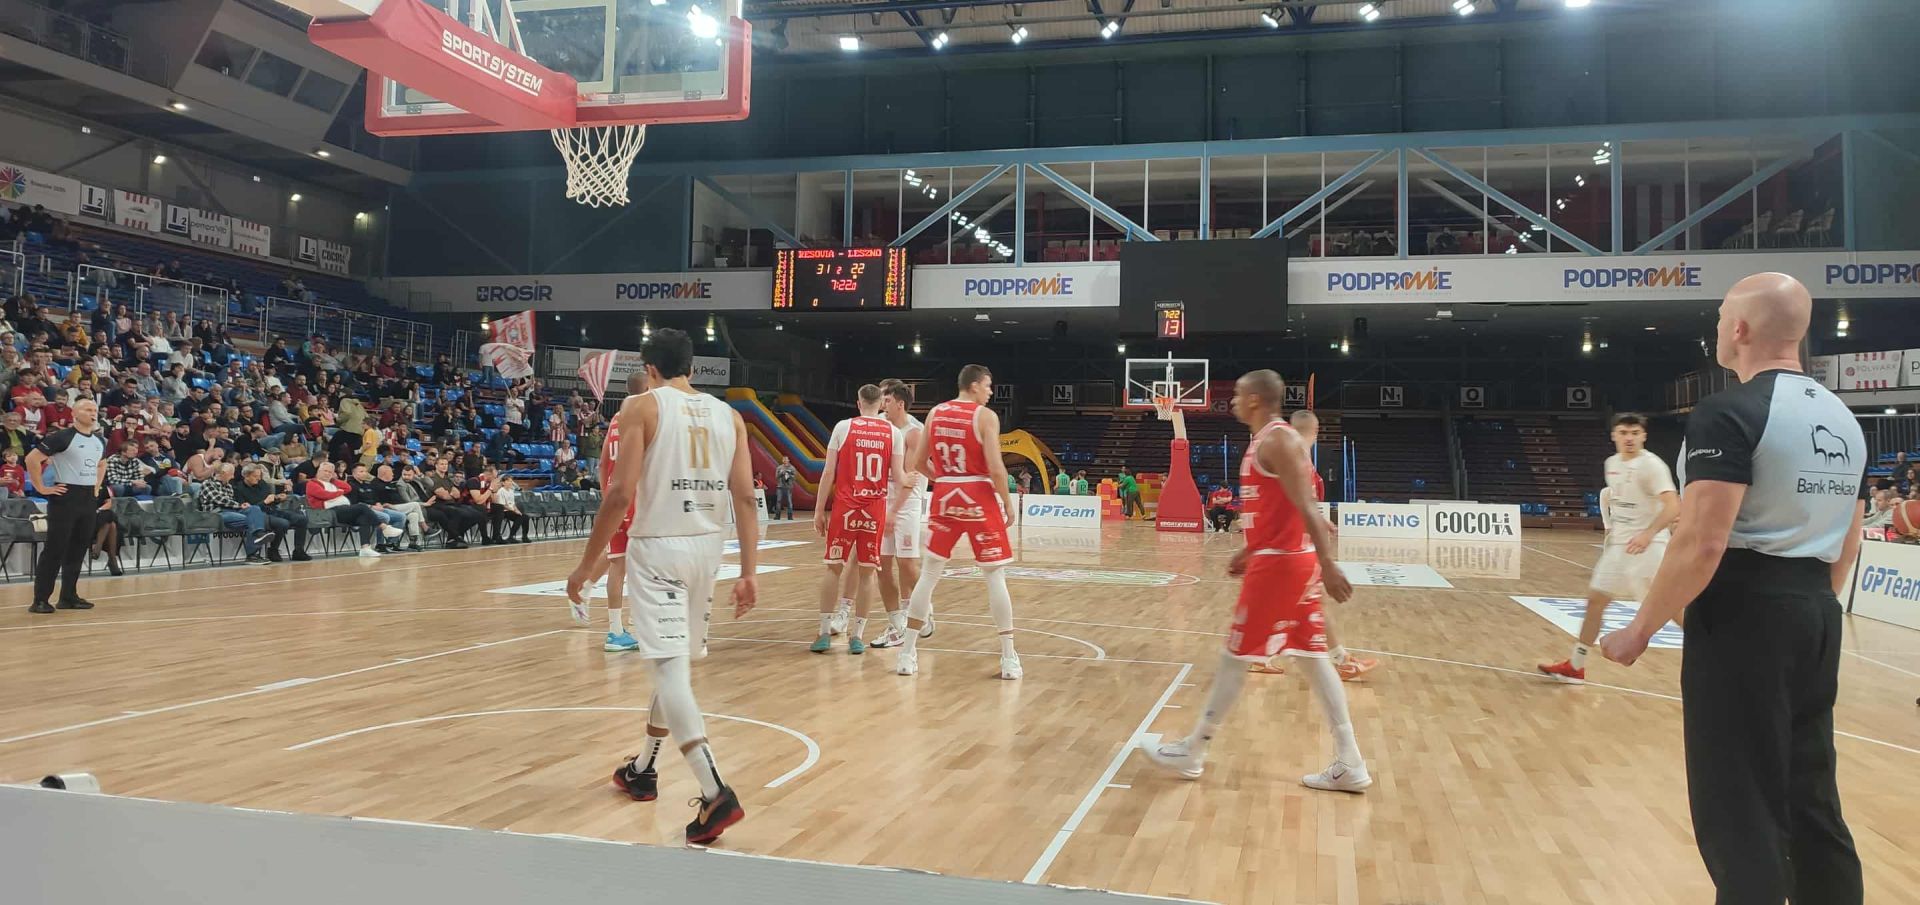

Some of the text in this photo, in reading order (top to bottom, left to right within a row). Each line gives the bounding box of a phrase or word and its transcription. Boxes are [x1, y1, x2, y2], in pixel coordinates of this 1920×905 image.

[848, 248, 882, 258] LESZNO
[816, 263, 830, 275] 31
[851, 263, 865, 274] 22
[1163, 310, 1180, 319] 7:22
[1164, 320, 1180, 335] 13
[934, 441, 967, 474] 33
[854, 452, 883, 483] 10
[1797, 478, 1856, 496] Bank Pekao
[850, 519, 877, 530] 4P4S
